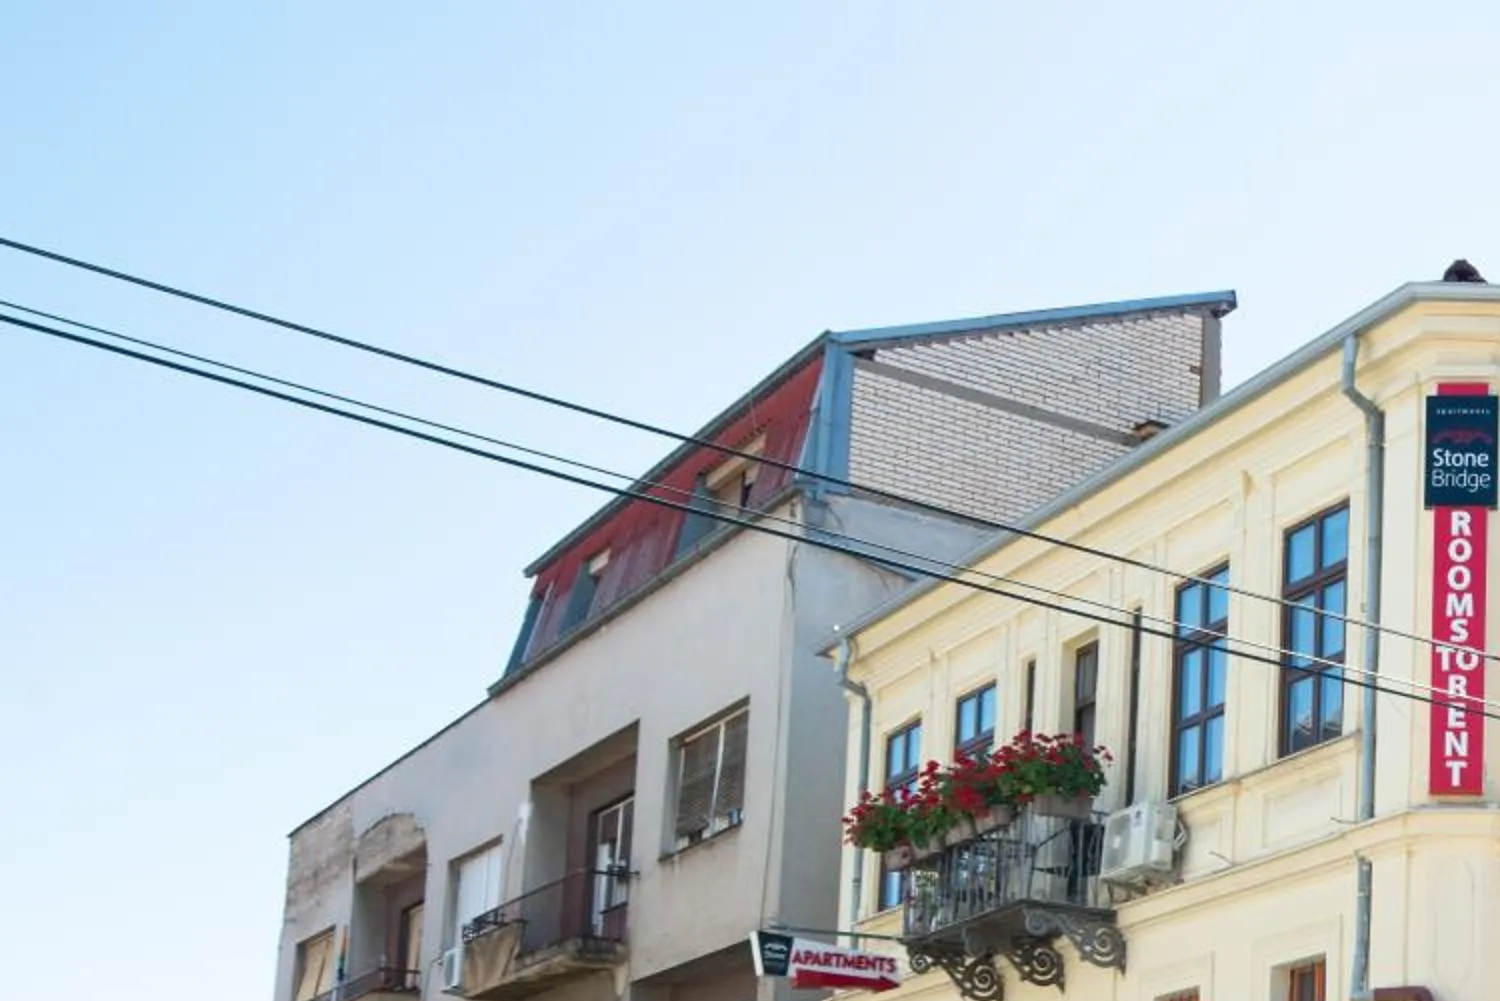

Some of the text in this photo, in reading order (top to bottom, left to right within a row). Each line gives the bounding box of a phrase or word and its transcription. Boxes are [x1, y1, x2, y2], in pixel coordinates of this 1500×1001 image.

[1432, 448, 1490, 468] Stone
[1431, 469, 1492, 493] Bridge
[1436, 510, 1480, 787] ROOMS TO RENT
[792, 950, 896, 973] APARTMENTS
